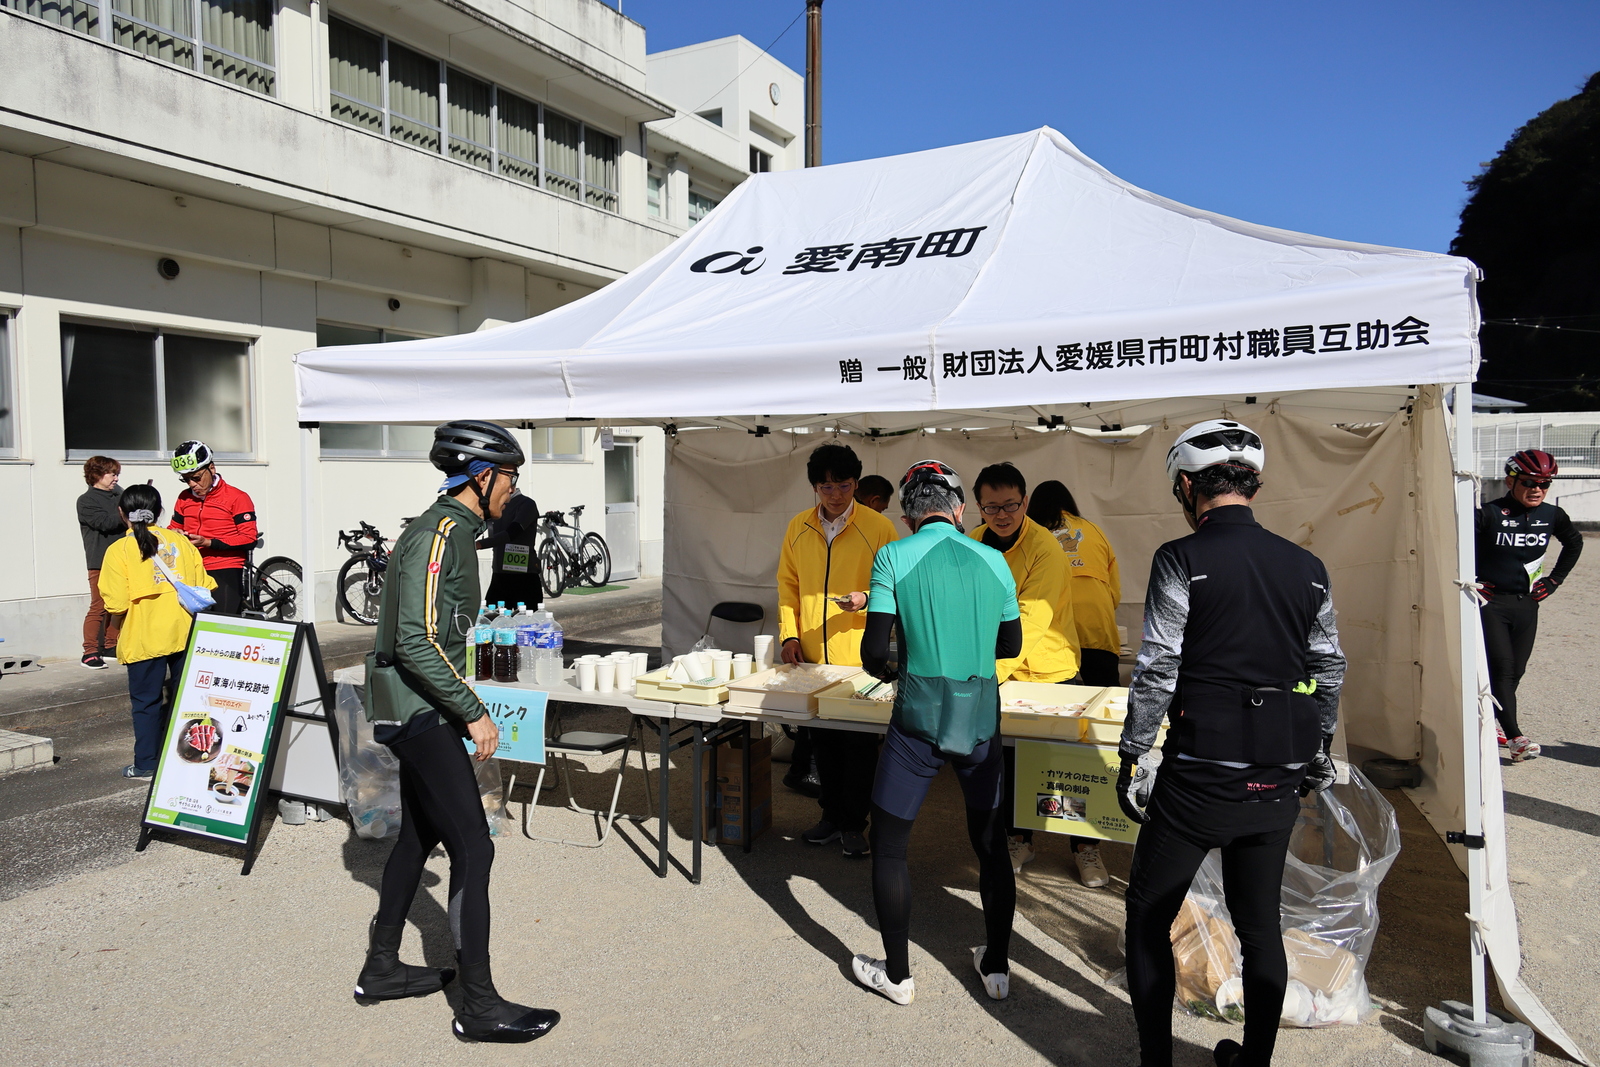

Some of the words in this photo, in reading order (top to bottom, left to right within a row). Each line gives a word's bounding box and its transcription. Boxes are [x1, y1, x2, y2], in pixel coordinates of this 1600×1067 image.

[782, 226, 988, 275] 愛南町
[173, 455, 195, 469] 038
[1495, 532, 1547, 547] INEOS
[507, 554, 526, 565] 002
[196, 646, 242, 660] スタートからの距離
[243, 644, 261, 662] 95
[198, 675, 211, 685] A6
[212, 676, 270, 695] 東海小学校跡地
[486, 702, 527, 721] リンク
